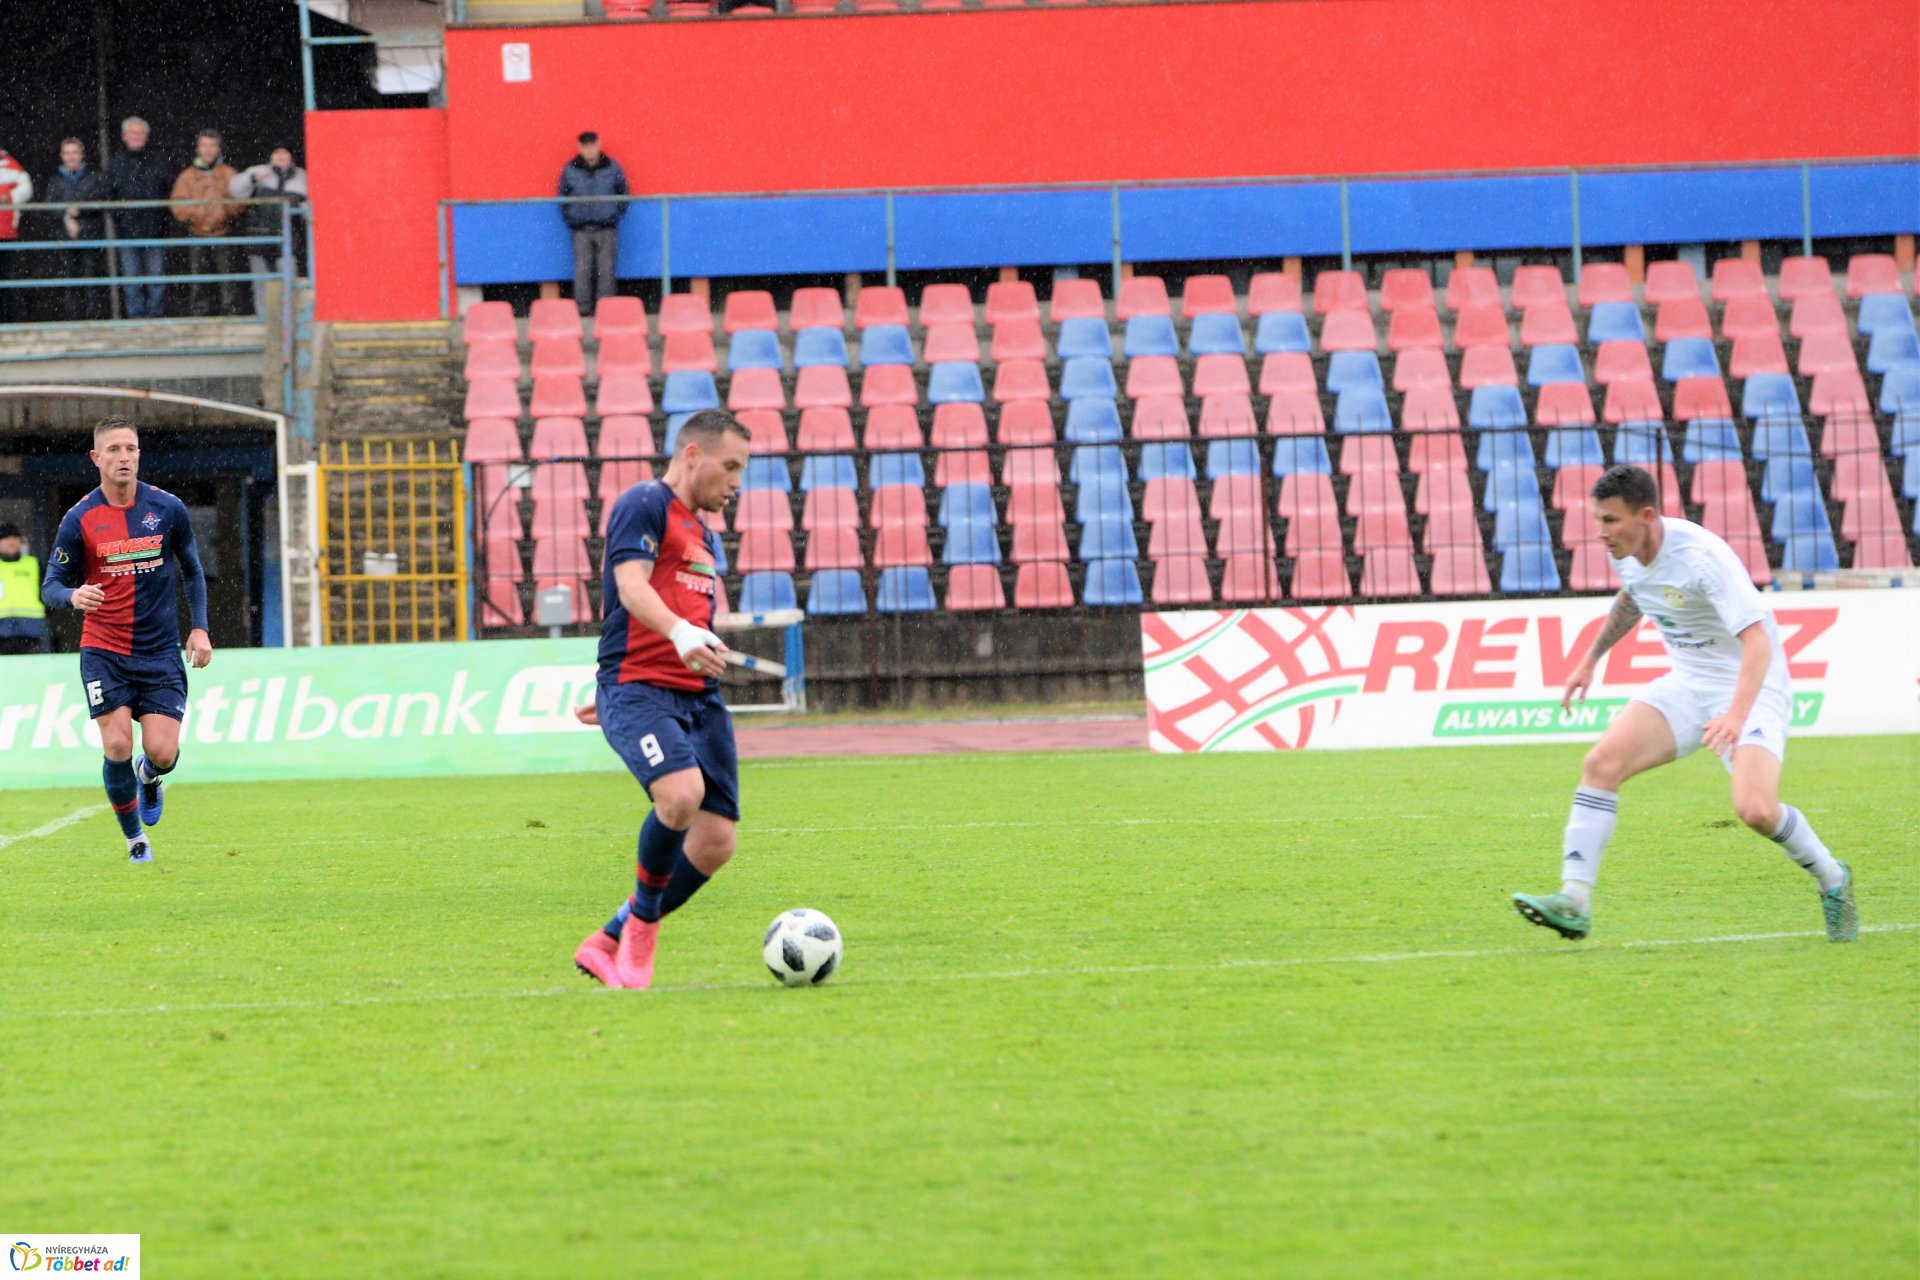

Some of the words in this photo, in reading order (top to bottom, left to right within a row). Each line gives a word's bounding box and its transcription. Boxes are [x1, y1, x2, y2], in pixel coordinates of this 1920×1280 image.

[97, 535, 163, 557] REVESZ
[1362, 607, 1840, 693] REVEZ
[0, 669, 490, 750] rktilbank
[1442, 707, 1553, 730] ALWAYS
[1558, 706, 1599, 726] ON
[640, 733, 665, 767] 9
